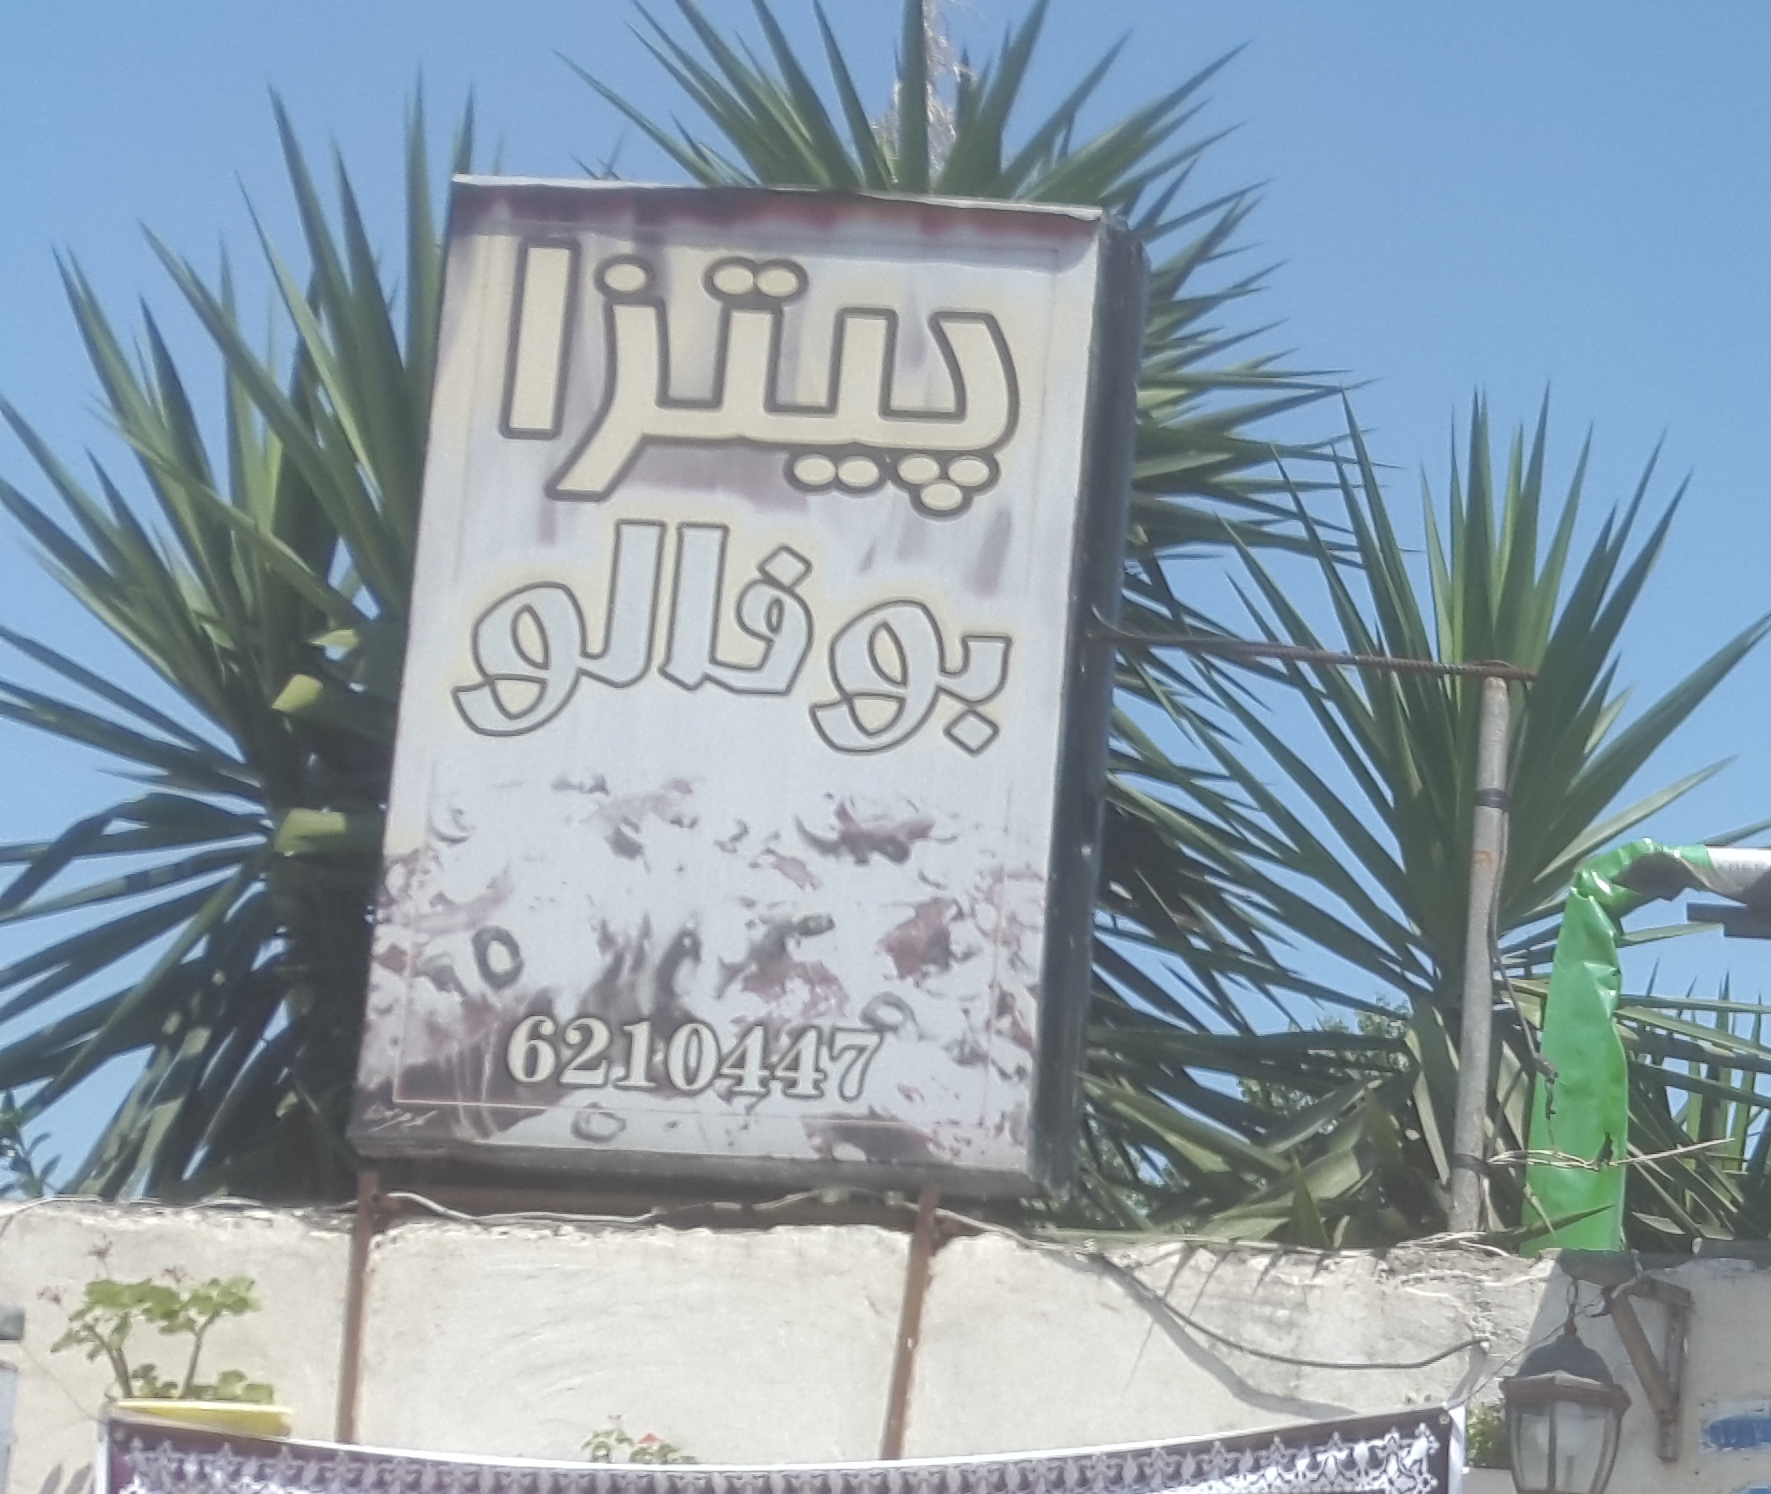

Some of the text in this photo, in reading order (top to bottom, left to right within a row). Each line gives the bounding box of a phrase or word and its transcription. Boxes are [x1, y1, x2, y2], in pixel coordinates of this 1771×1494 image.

[499, 235, 1020, 522] پیتزا
[451, 517, 1013, 757] بوفالو
[505, 1013, 884, 1103] 6210447
